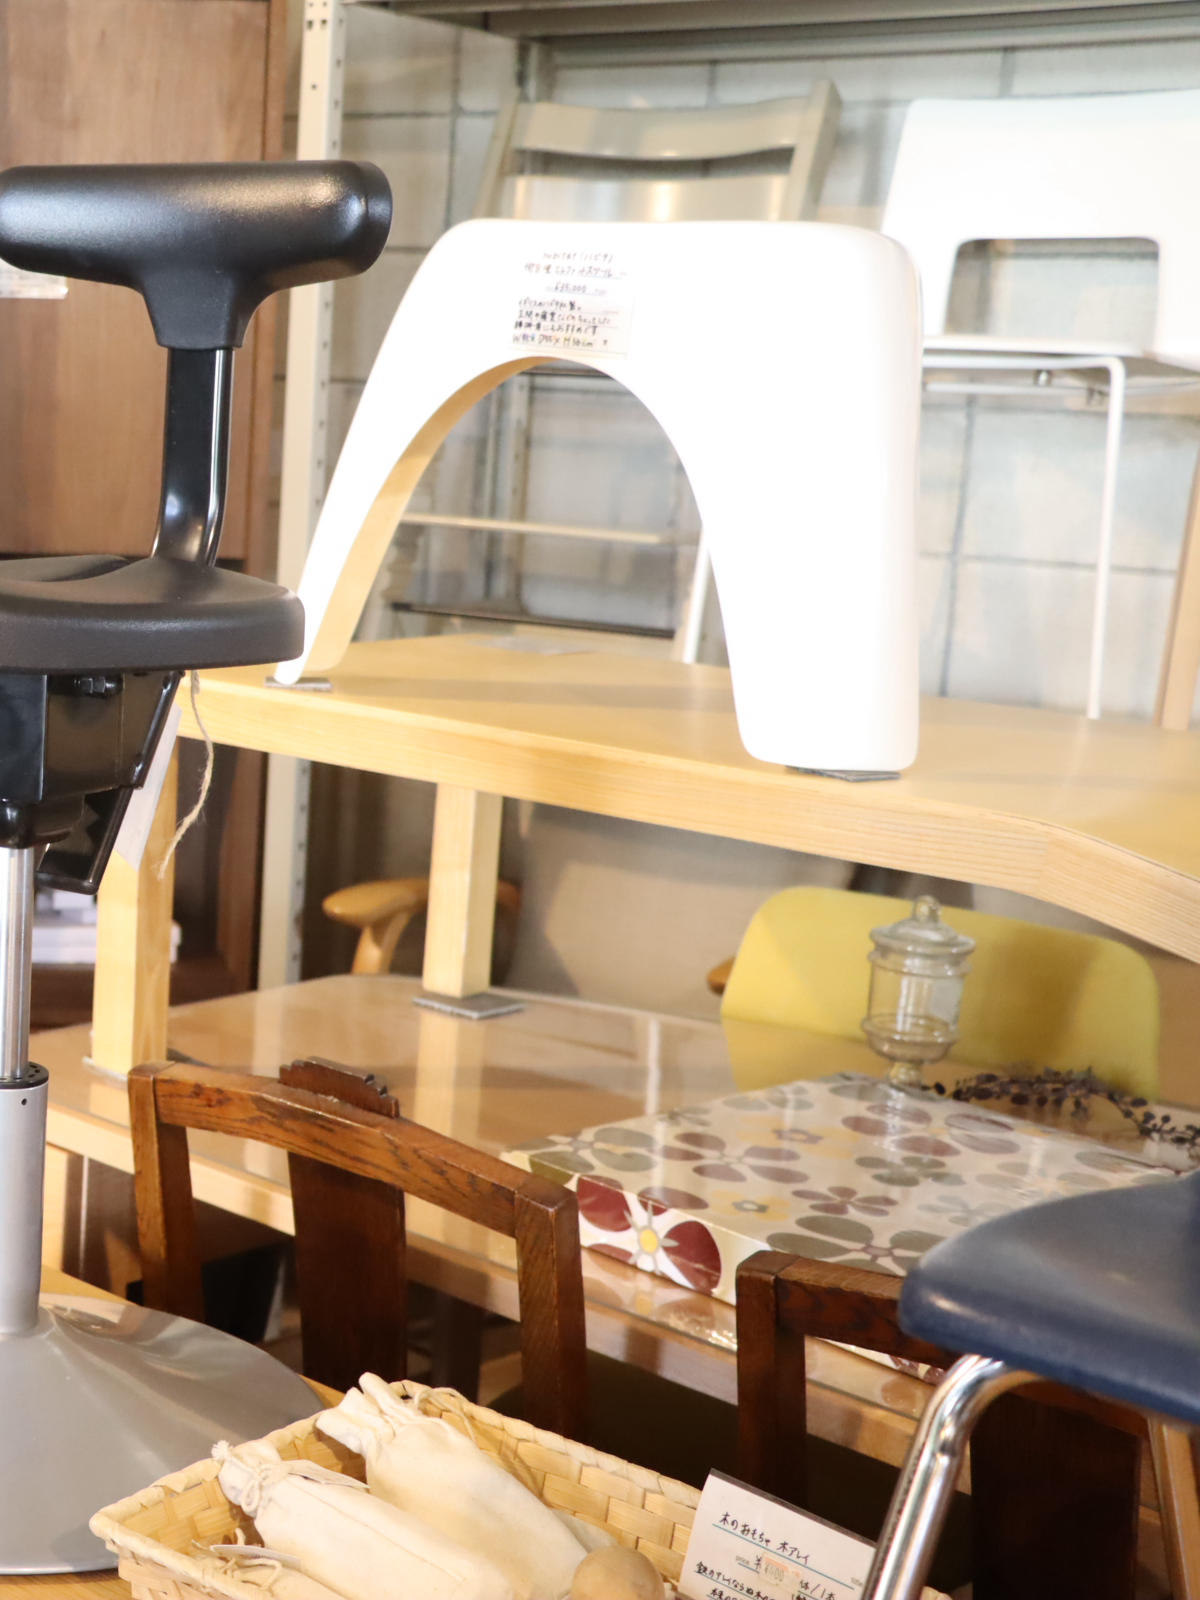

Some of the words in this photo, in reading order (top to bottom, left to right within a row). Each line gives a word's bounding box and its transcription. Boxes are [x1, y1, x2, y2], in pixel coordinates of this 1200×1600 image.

[719, 1511, 771, 1546] 木のおもちゃ
